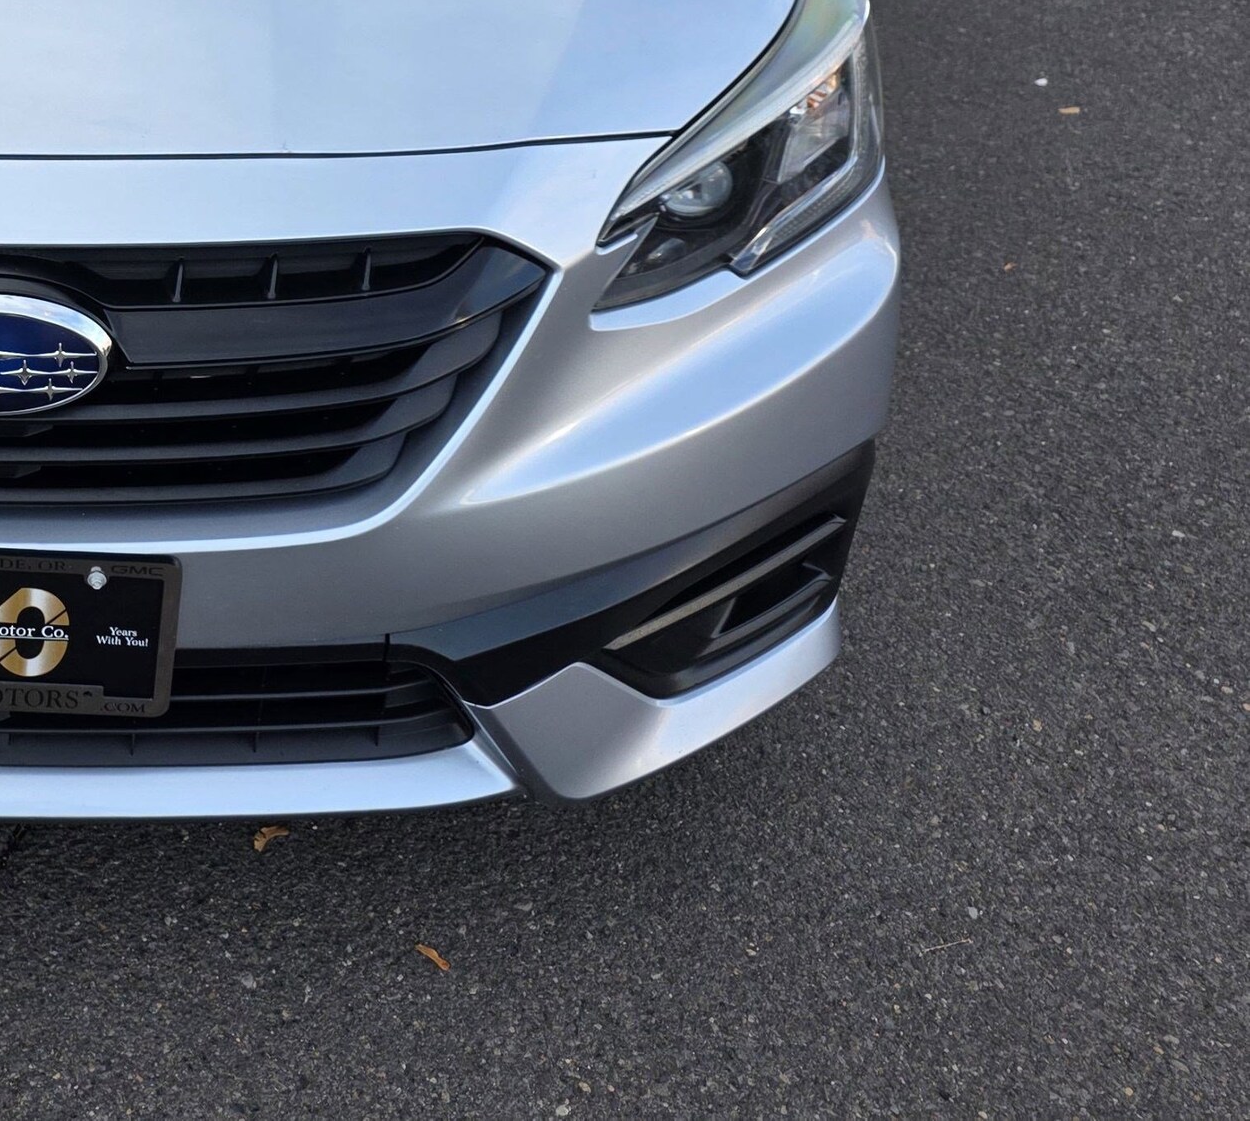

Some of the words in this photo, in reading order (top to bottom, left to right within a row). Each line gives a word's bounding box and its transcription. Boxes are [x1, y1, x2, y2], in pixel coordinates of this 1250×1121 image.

[38, 560, 66, 572] OR
[110, 565, 165, 577] GMC
[41, 625, 69, 639] Co.
[108, 626, 138, 637] Years
[96, 634, 122, 646] With
[125, 637, 149, 648] You!
